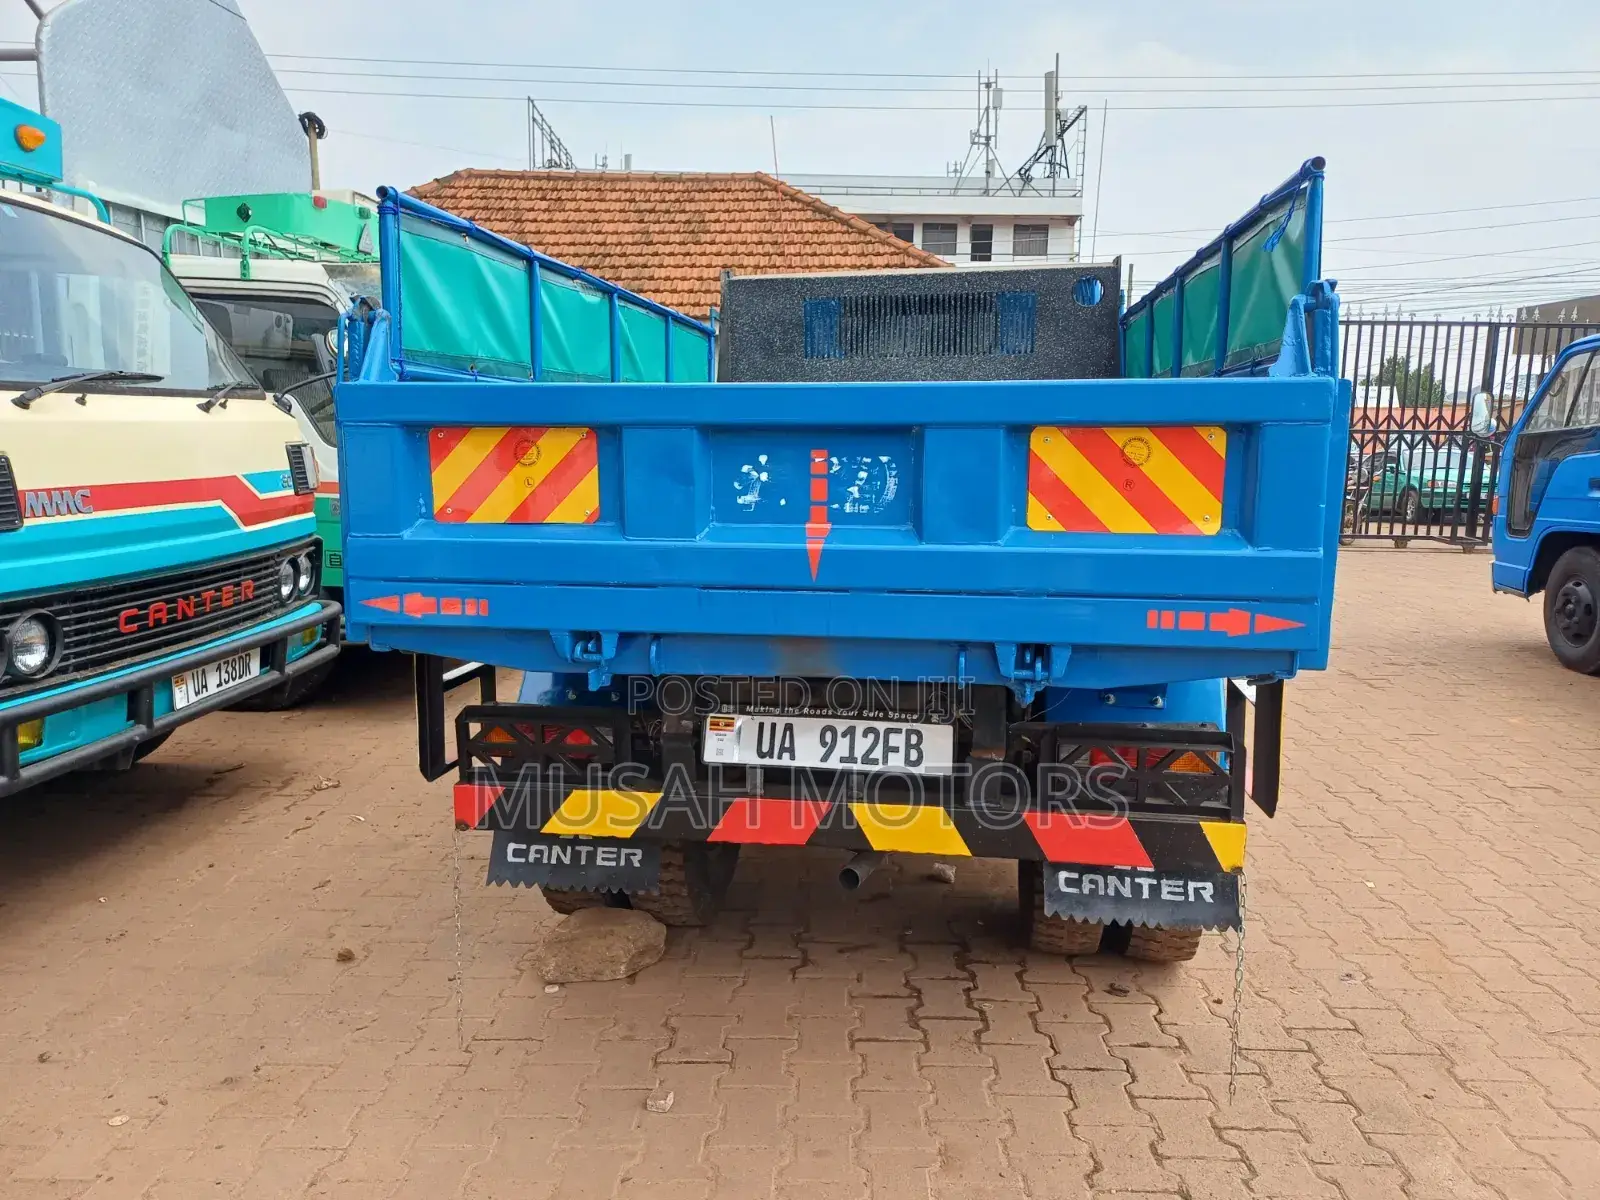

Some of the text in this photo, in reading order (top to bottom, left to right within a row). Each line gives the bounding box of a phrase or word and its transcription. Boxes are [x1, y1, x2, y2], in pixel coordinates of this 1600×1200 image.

[25, 489, 94, 518] MMC
[118, 579, 255, 634] CANTER
[191, 652, 252, 697] UA 138DR
[745, 705, 780, 715] Making
[783, 706, 800, 715] the
[803, 707, 833, 716] Roads
[838, 708, 858, 717] Your
[862, 709, 884, 718] Safe
[888, 710, 919, 720] Space
[756, 721, 924, 767] UA 912FB
[506, 842, 643, 868] CANTER
[1058, 870, 1215, 904] CANTER
